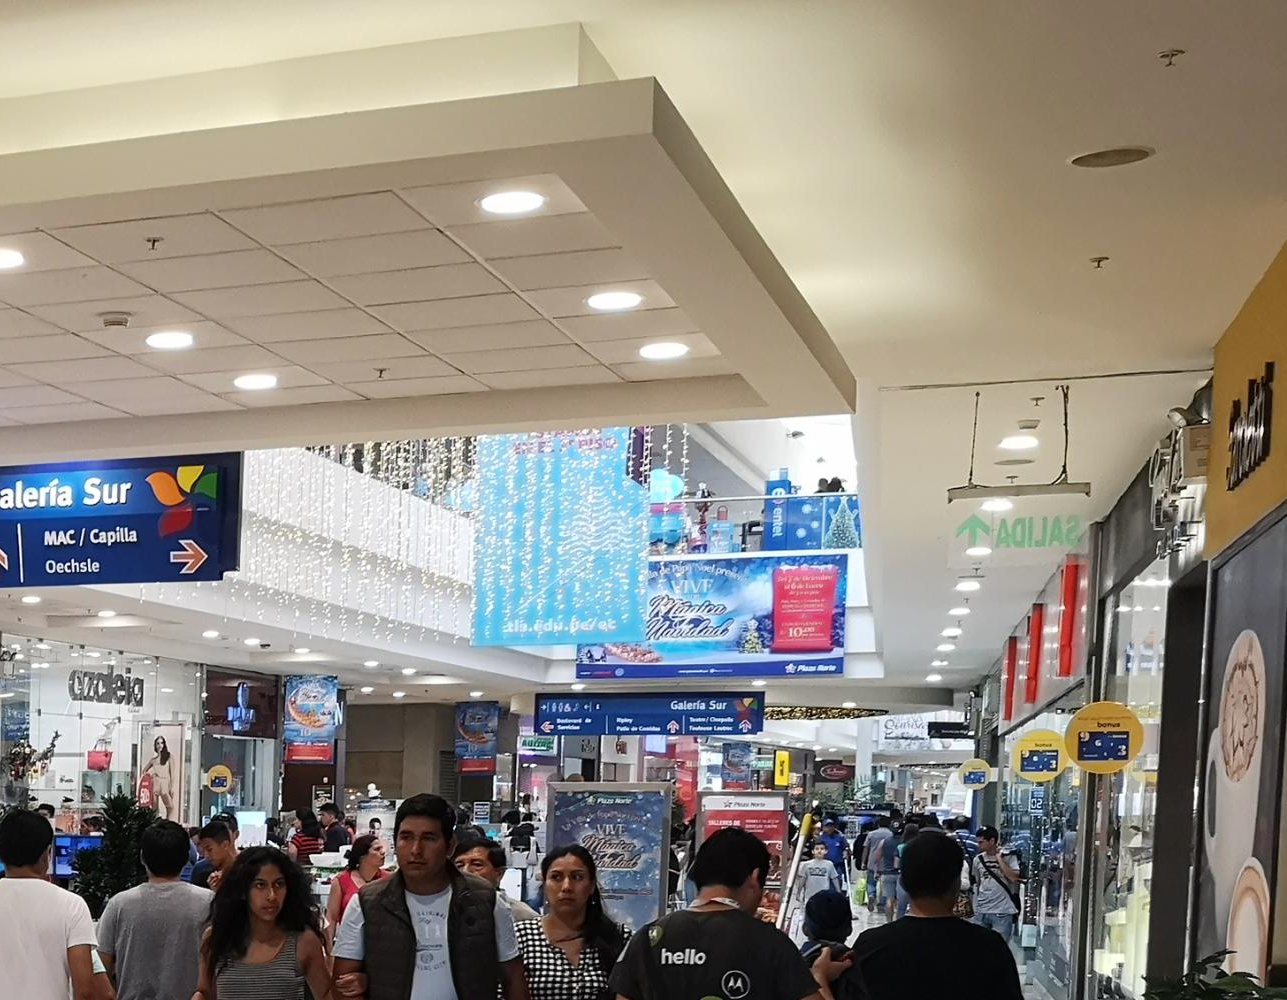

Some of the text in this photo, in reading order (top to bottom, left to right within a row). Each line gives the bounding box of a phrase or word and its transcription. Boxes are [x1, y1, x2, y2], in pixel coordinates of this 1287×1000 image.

[82, 477, 133, 506] Sur
[772, 508, 784, 538] entel
[44, 530, 76, 546] MAC
[89, 527, 137, 545] Capilla
[45, 559, 100, 574] Oechsle
[670, 700, 727, 711] Galería Sur
[1097, 721, 1120, 729] bonus
[661, 948, 707, 965] hello
